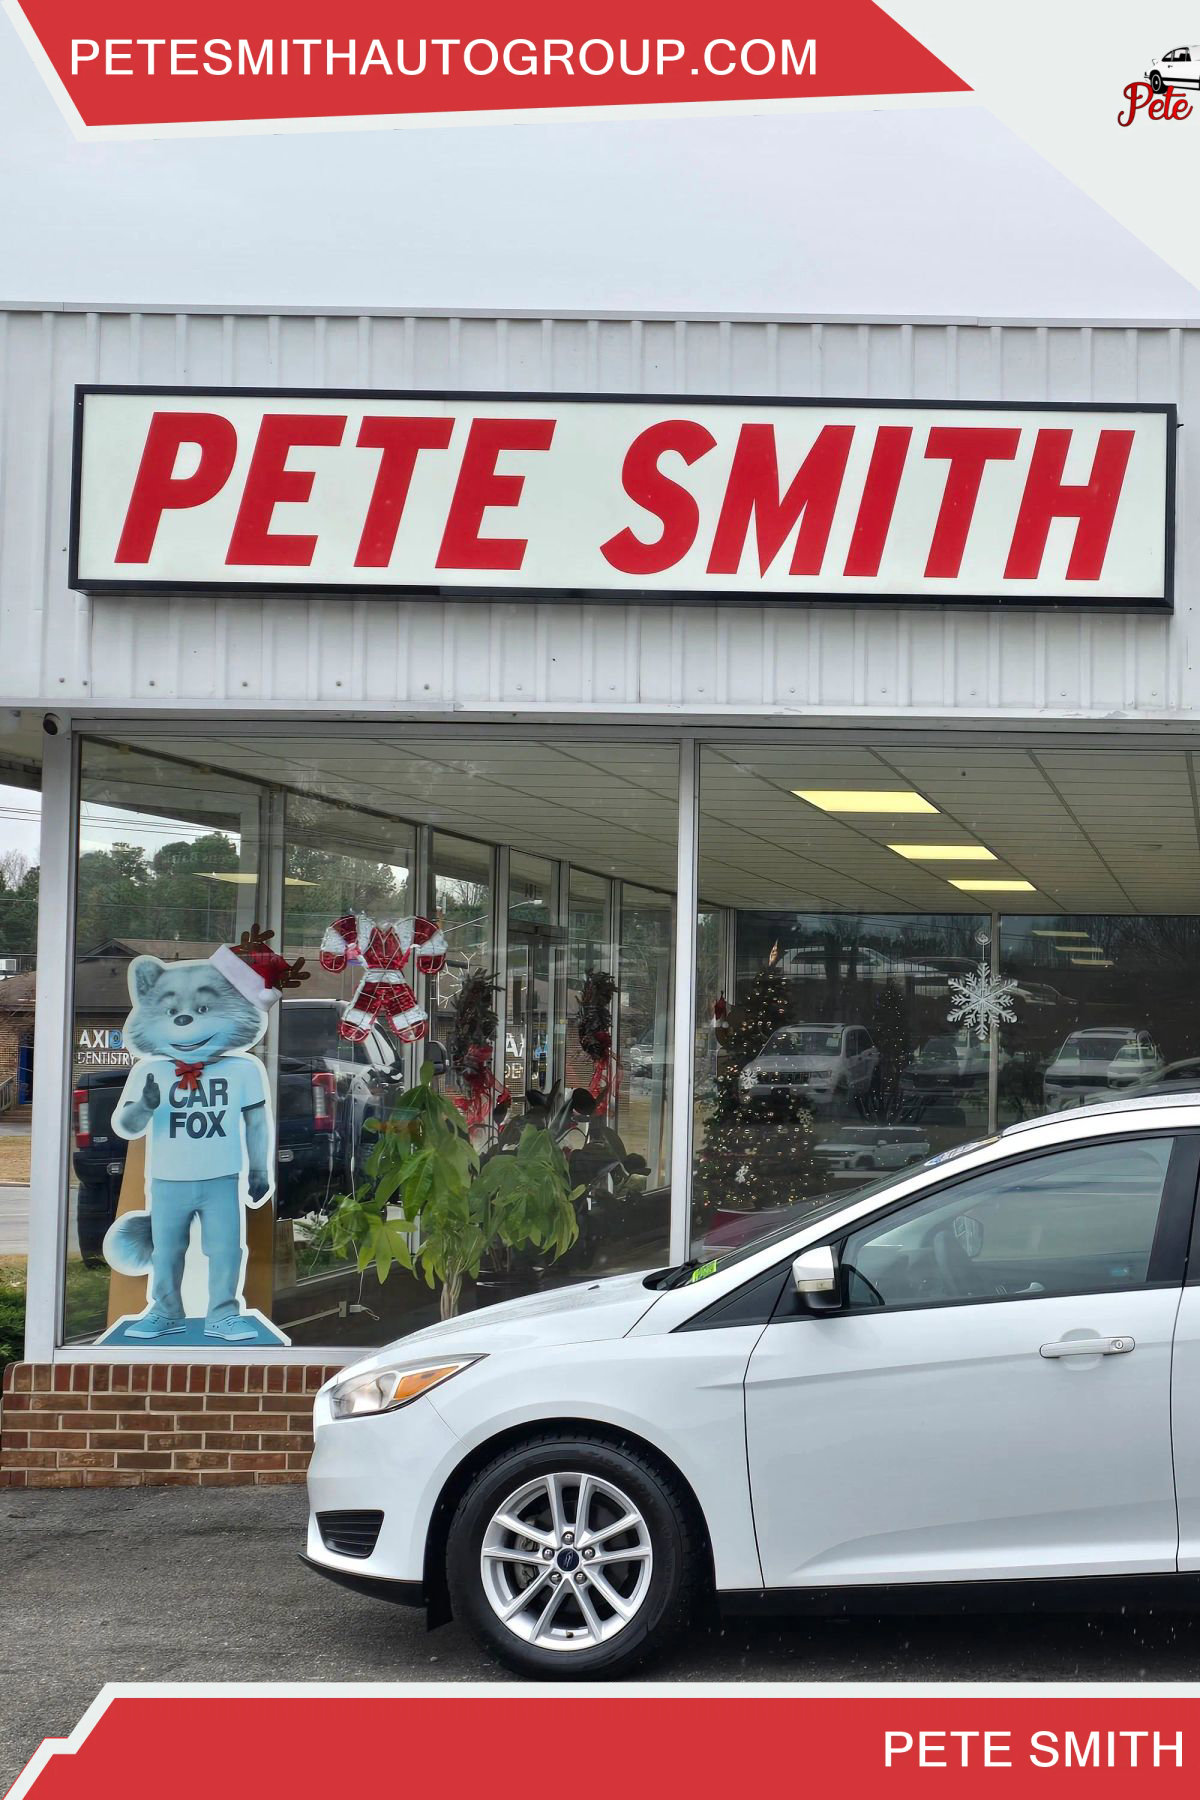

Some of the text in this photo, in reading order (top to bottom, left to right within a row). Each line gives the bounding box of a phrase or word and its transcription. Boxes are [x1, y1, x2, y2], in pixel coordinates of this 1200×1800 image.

[113, 411, 1136, 581] PETE SMITH
[77, 1052, 135, 1066] DENTISTRY
[168, 1077, 229, 1109] CAR
[169, 1109, 227, 1139] FOX
